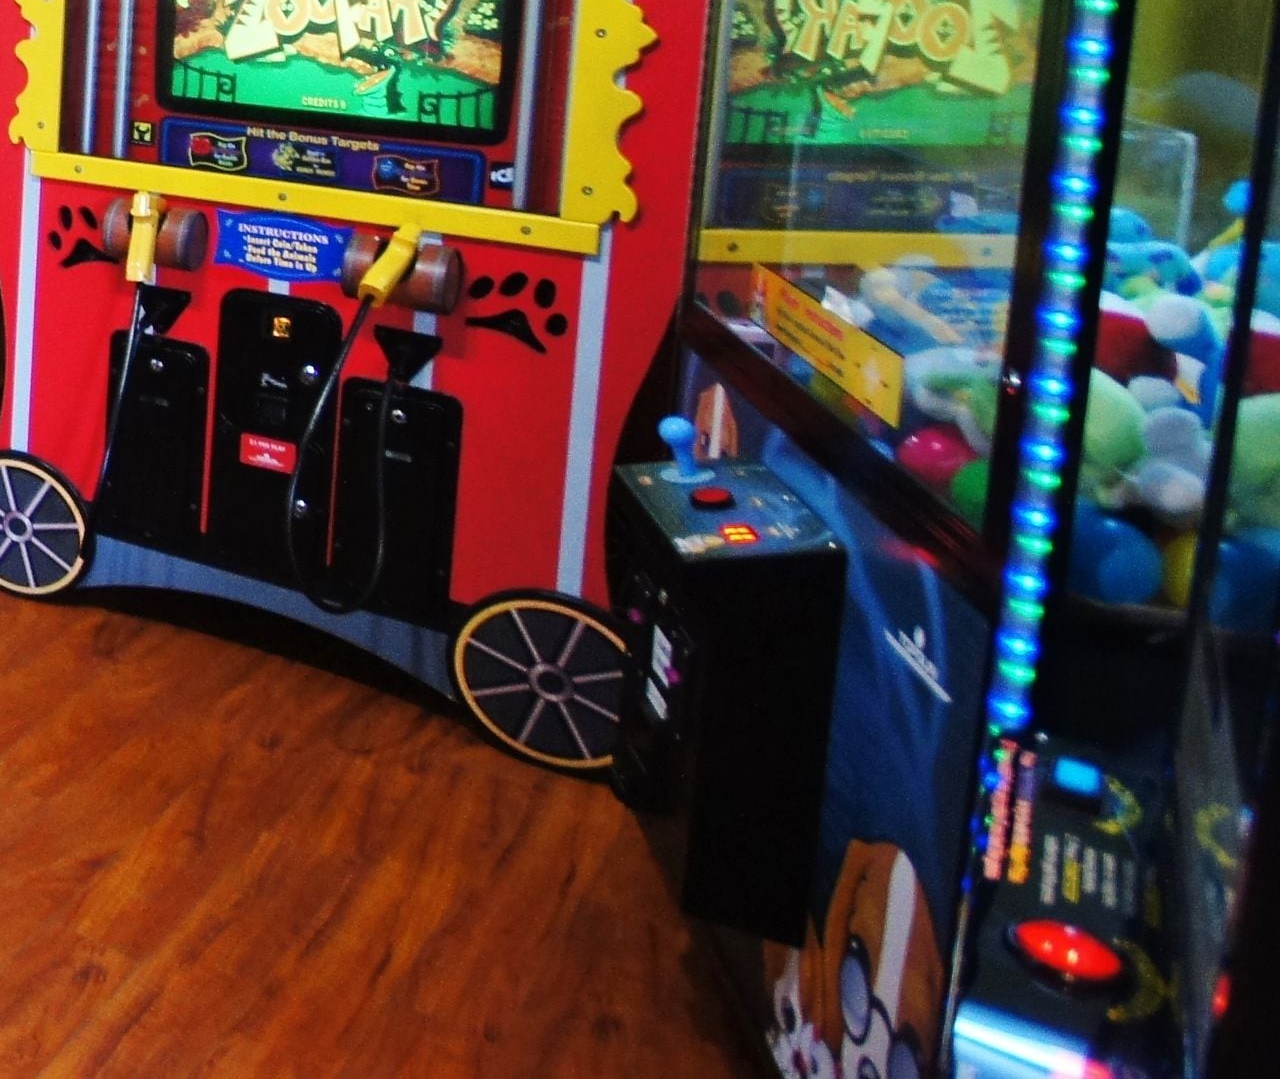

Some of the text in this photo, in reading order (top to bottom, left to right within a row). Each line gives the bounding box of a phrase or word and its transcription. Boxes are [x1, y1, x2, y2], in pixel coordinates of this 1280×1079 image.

[302, 96, 339, 109] CREDITS
[246, 126, 380, 152] Hit the Bonus Targets
[238, 223, 329, 245] INSTRUCTIONS
[246, 234, 271, 246] Insert
[267, 247, 281, 257] the
[282, 250, 317, 263] Animals
[274, 257, 294, 269] Time
